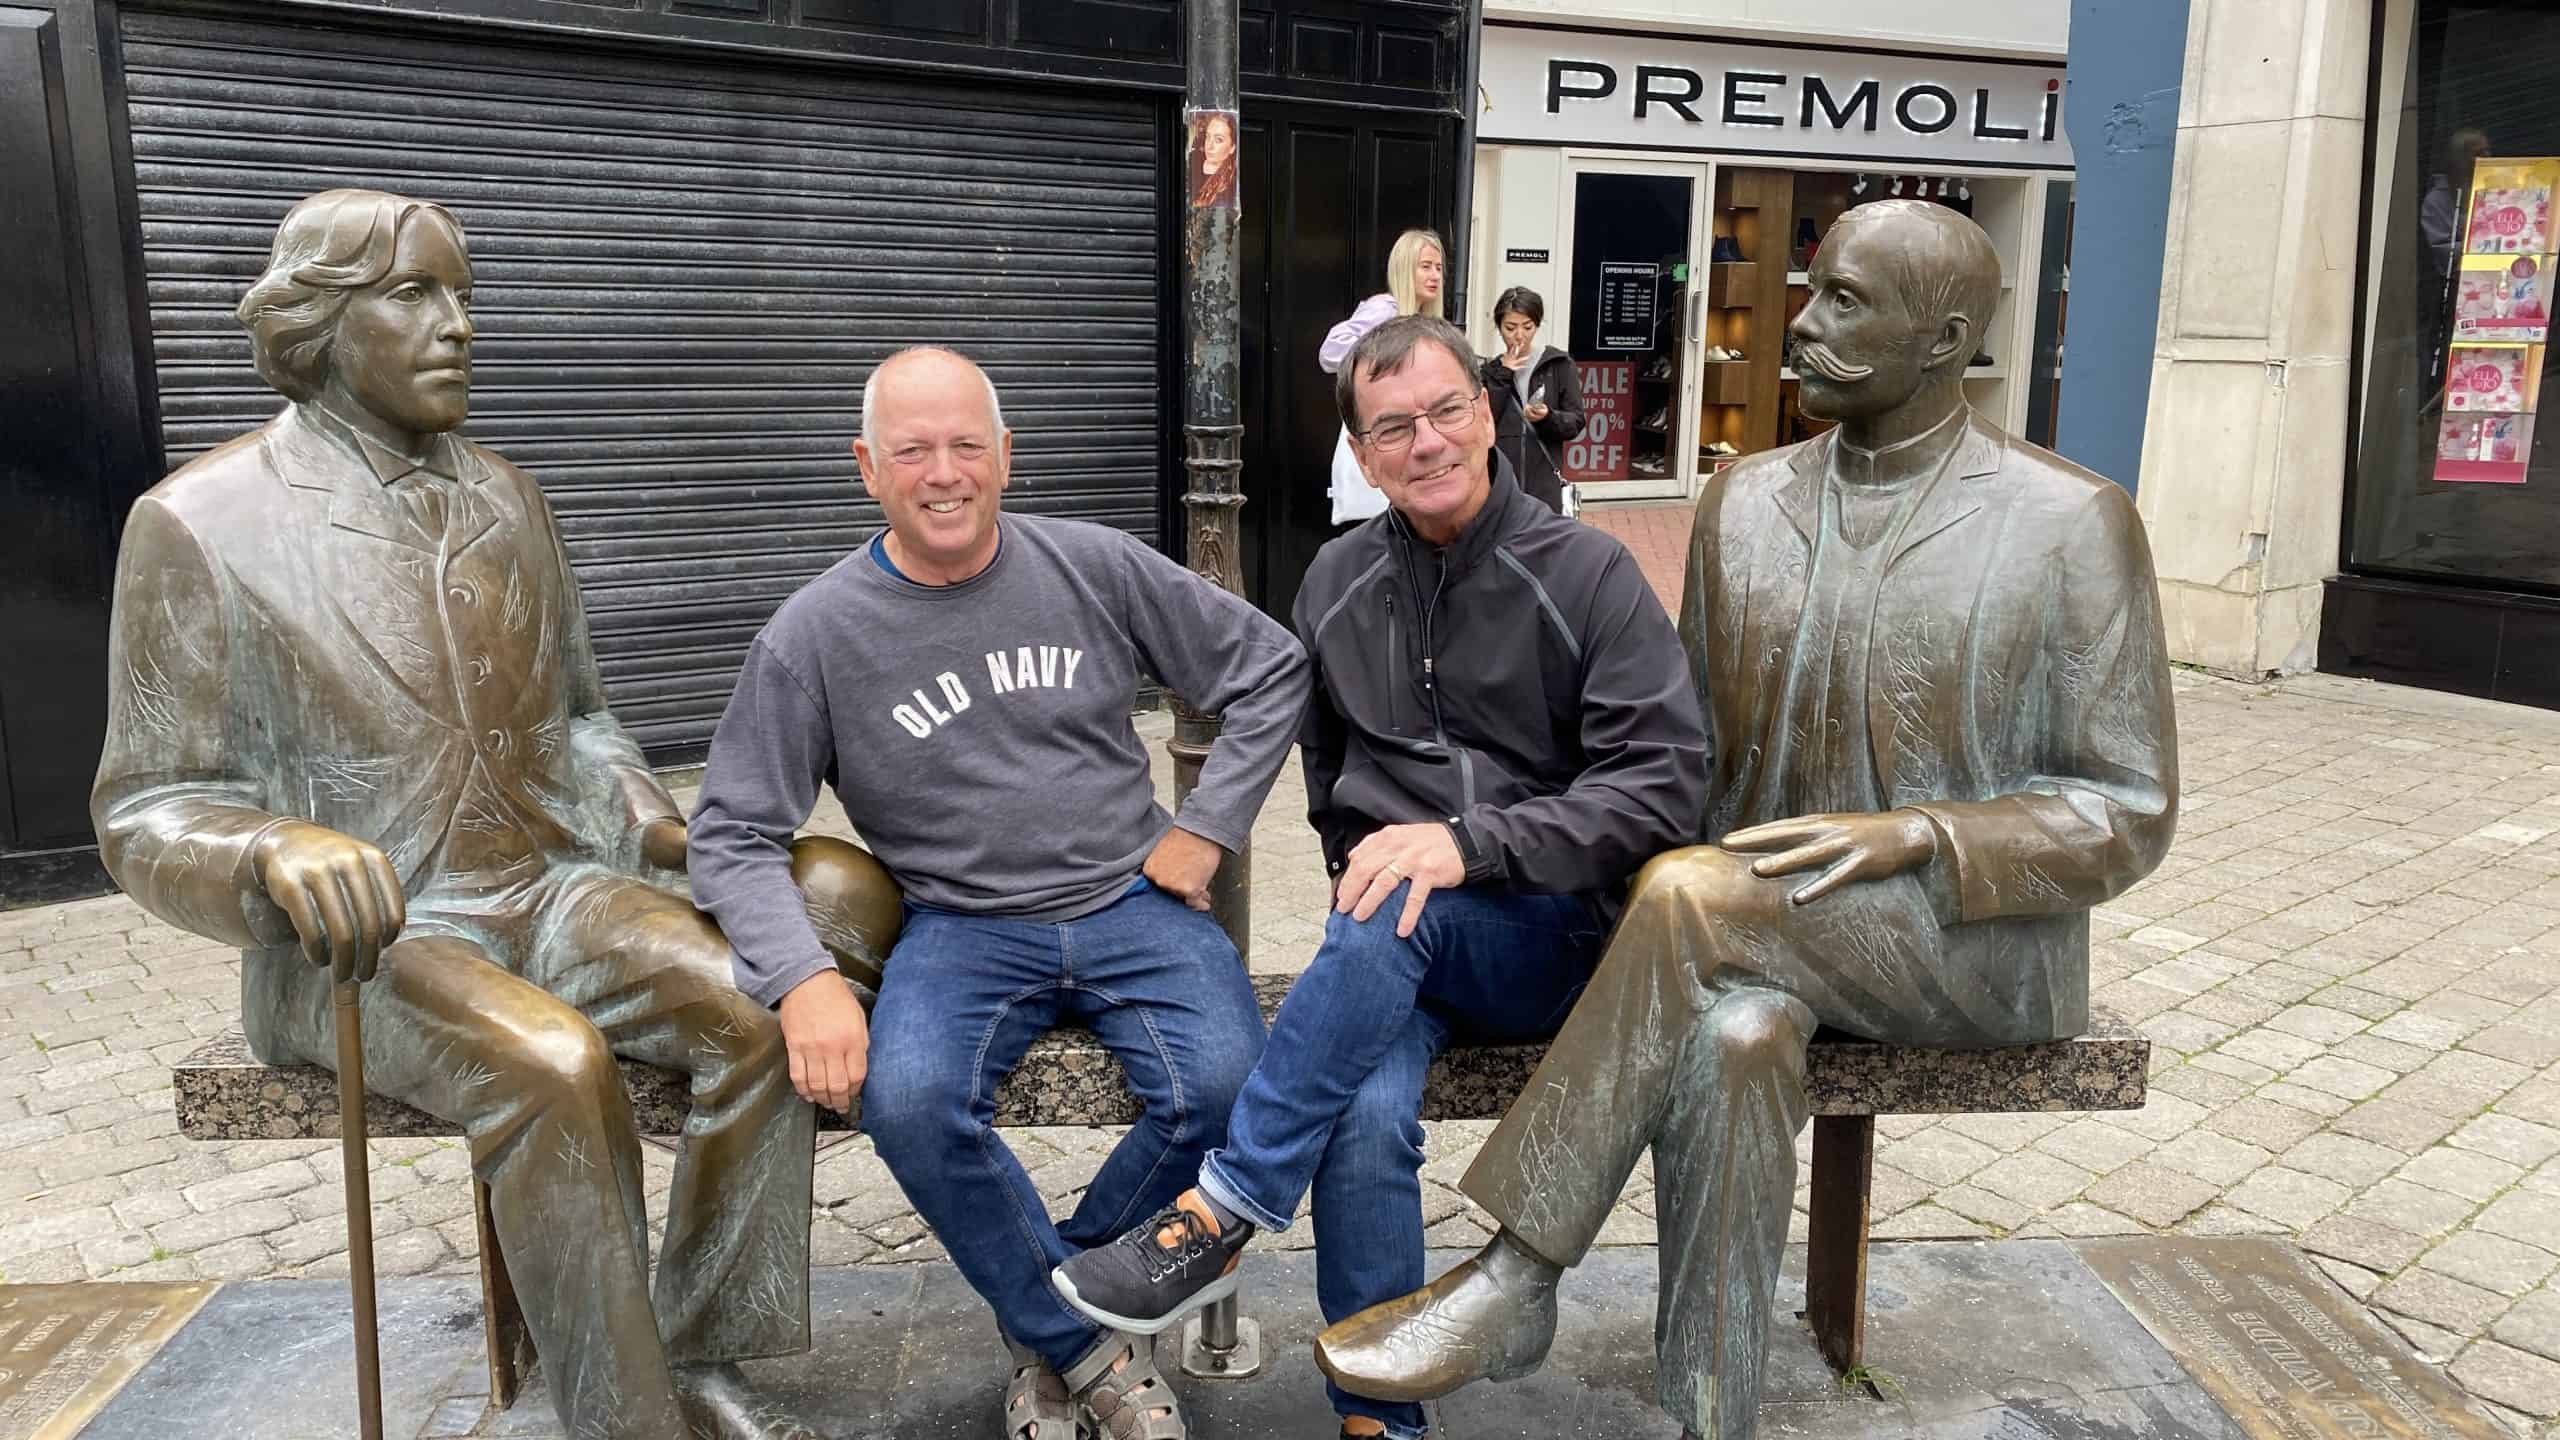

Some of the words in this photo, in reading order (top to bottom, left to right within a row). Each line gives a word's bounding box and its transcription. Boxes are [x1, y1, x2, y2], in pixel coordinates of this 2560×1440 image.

[1582, 398, 1597, 409] UP
[1600, 398, 1615, 409] TO
[1567, 444, 1624, 471] OFF
[892, 671, 971, 739] OLD
[985, 645, 1083, 694] NAVY
